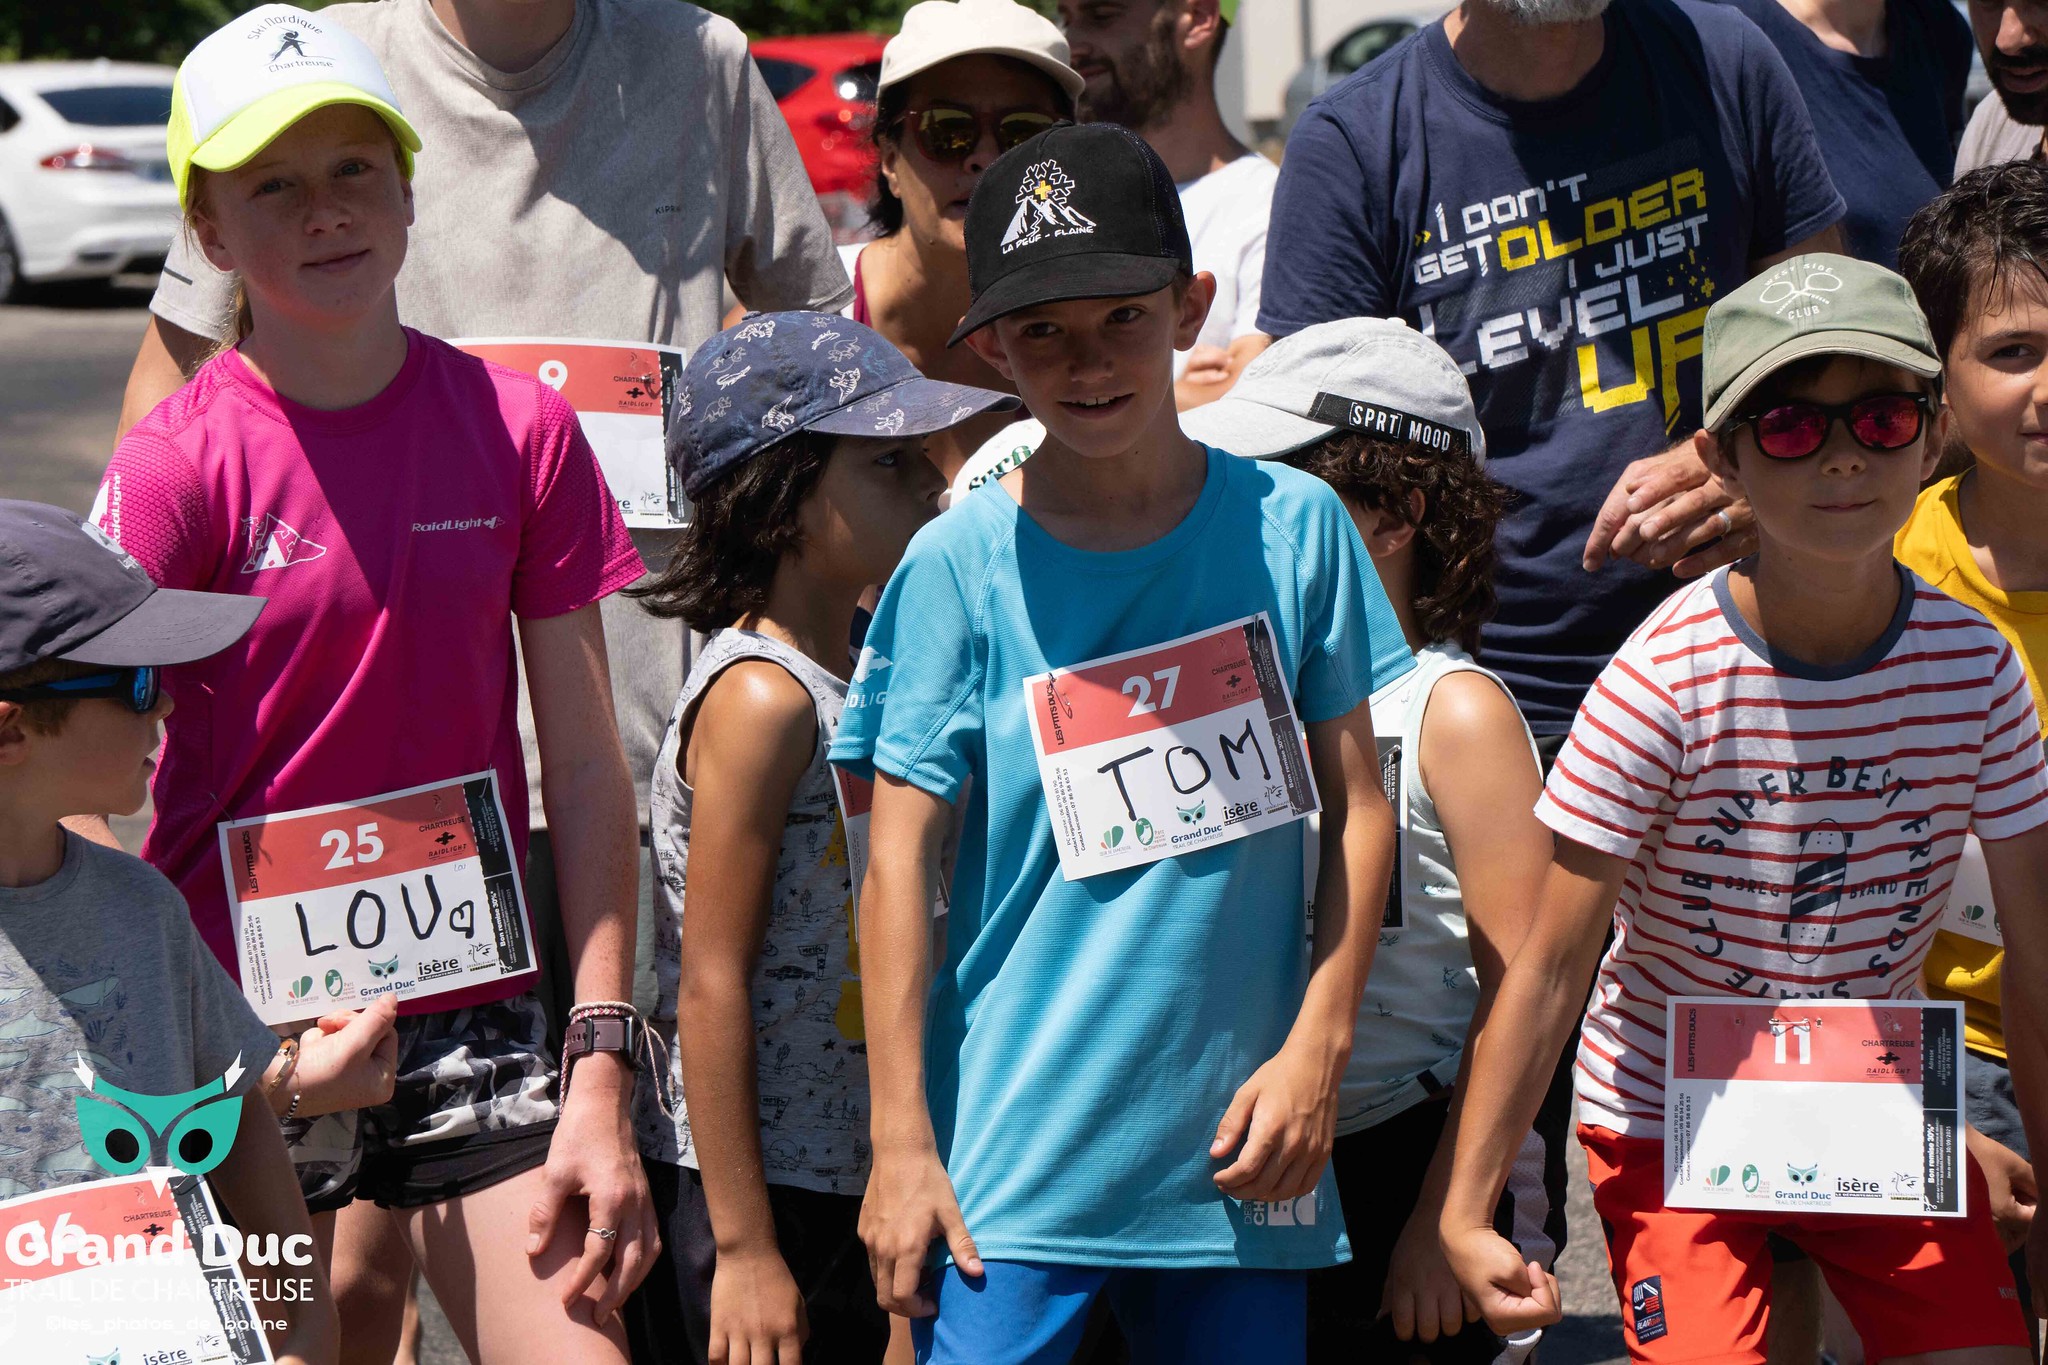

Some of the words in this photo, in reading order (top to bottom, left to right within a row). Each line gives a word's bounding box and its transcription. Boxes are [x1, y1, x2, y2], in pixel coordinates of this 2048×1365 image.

[268, 60, 334, 73] Chartreuse
[1413, 235, 1492, 285] GET
[1497, 167, 1707, 272] OLDER
[1002, 244, 1014, 254] LA
[1016, 233, 1042, 249] PEUF
[1054, 225, 1094, 238] FLAINE
[1594, 213, 1709, 278] JUST
[1764, 266, 1796, 286] WEST
[1803, 263, 1834, 274] SIDE
[1788, 305, 1820, 320] CLUB
[538, 360, 568, 391] 9
[1409, 420, 1451, 452] MOOD
[411, 518, 482, 533] RaidLight
[1210, 658, 1247, 675] CHARTREUSE
[1045, 683, 1055, 705] DUCS
[1121, 665, 1181, 718] 27
[1055, 729, 1064, 745] LES
[1097, 718, 1271, 821] TOM
[1279, 750, 1290, 773] remise
[1286, 773, 1294, 788] Bon
[1827, 756, 1913, 808] BEST
[1223, 798, 1258, 819] isère
[1695, 767, 1809, 855] SUPER
[418, 816, 465, 832] CHARTREUSE
[1170, 828, 1202, 844] Grand
[1203, 823, 1222, 835] Duc
[241, 830, 252, 853] DUCS
[319, 822, 385, 870] 25
[1193, 831, 1223, 844] CHARTREUSE
[427, 843, 467, 856] RAIDLIGHT
[249, 877, 258, 893] LES
[1850, 880, 1898, 899] BRAND
[1868, 815, 1932, 978] FRIENDS
[493, 908, 503, 931] remise
[1681, 871, 1724, 958] CLUB
[497, 932, 506, 946] Bon
[253, 953, 263, 984] organisation
[418, 956, 459, 975] isère
[258, 984, 266, 1004] Contact
[359, 982, 392, 996] Grand
[394, 979, 414, 989] Duc
[1688, 1008, 1696, 1031] DUCS
[1771, 1025, 1811, 1065] 11
[1861, 1039, 1914, 1047] CHARTREUSE
[1775, 1190, 1807, 1198] Grand
[1811, 1191, 1830, 1199] Duc
[1837, 1178, 1880, 1193] isère
[123, 1209, 171, 1222] CHARTREUSE
